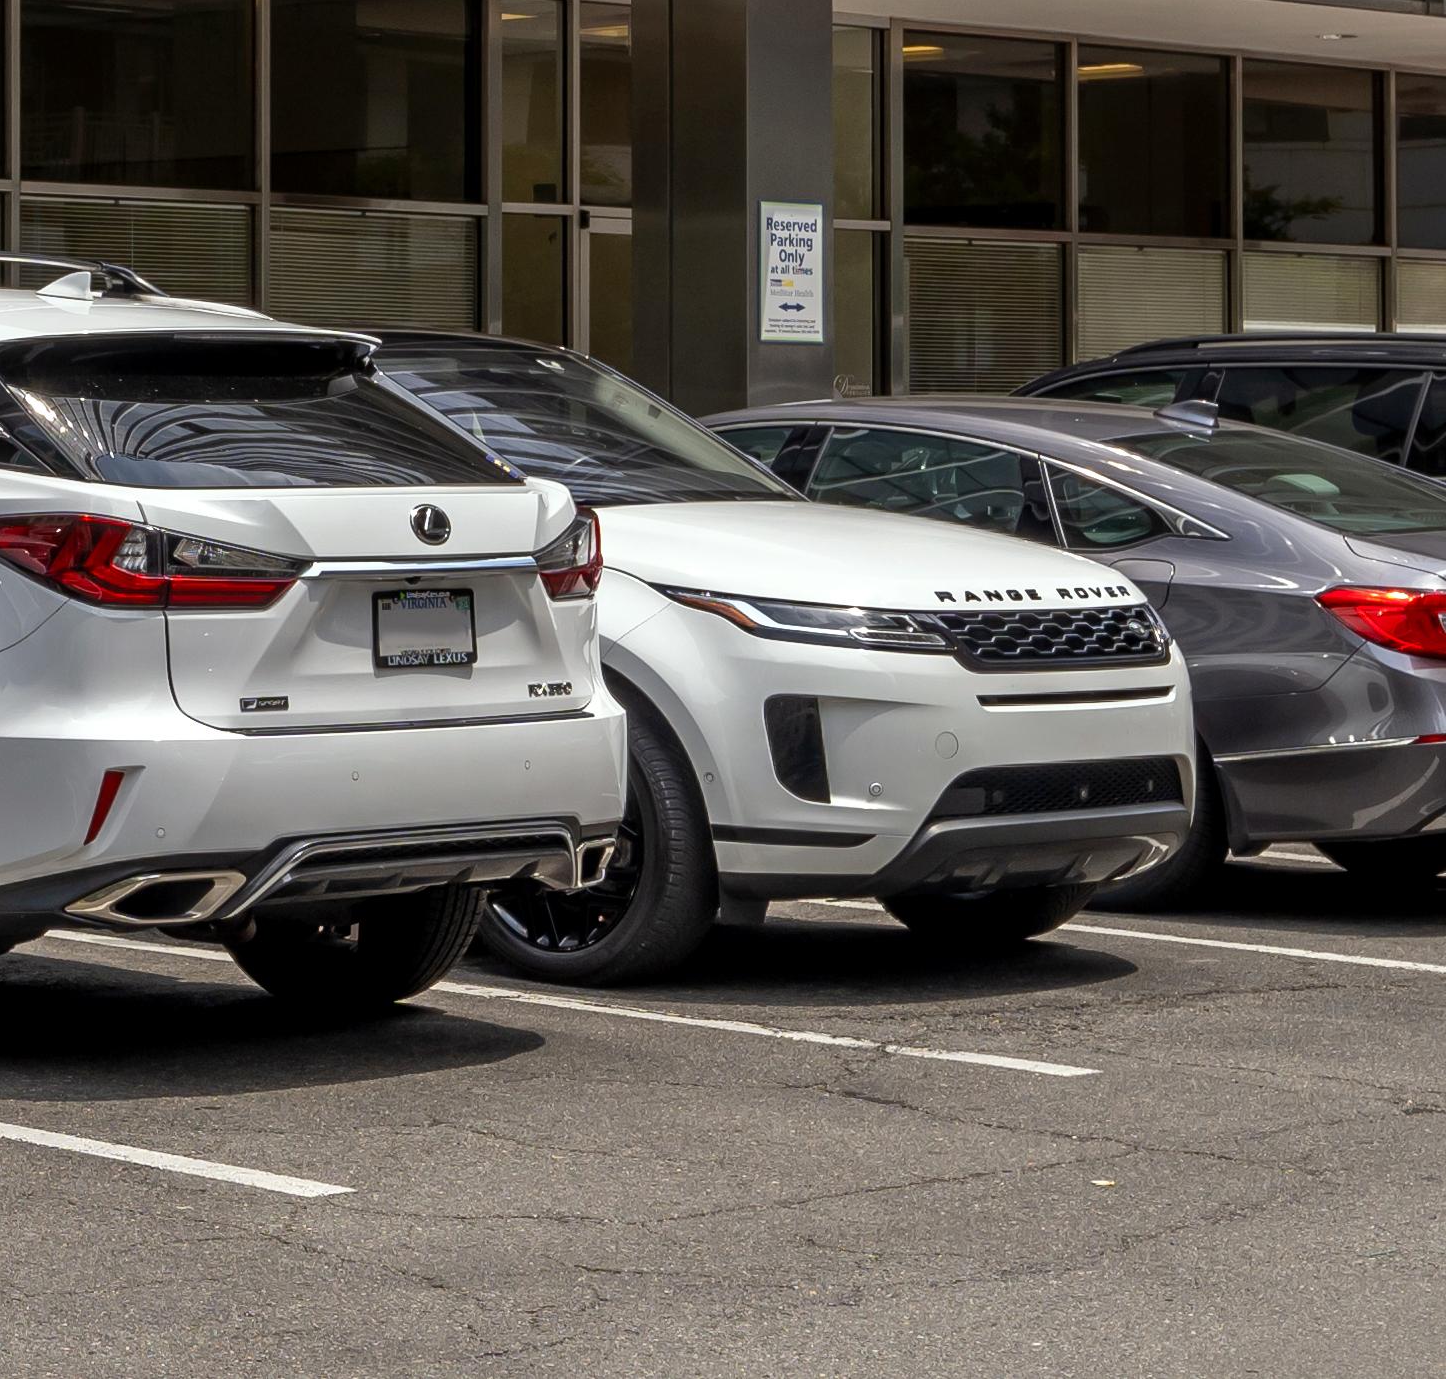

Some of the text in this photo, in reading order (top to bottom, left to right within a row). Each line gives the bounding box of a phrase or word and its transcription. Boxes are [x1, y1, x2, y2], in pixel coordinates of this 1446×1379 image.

[766, 217, 817, 233] Reserved
[770, 233, 813, 252] Parking
[779, 249, 805, 267] Only
[770, 265, 813, 276] at all times
[934, 585, 1131, 603] RANGE ROVER
[401, 596, 447, 609] VIRGINIA
[388, 654, 430, 666] LINDSAY
[433, 652, 468, 664] LEXUS
